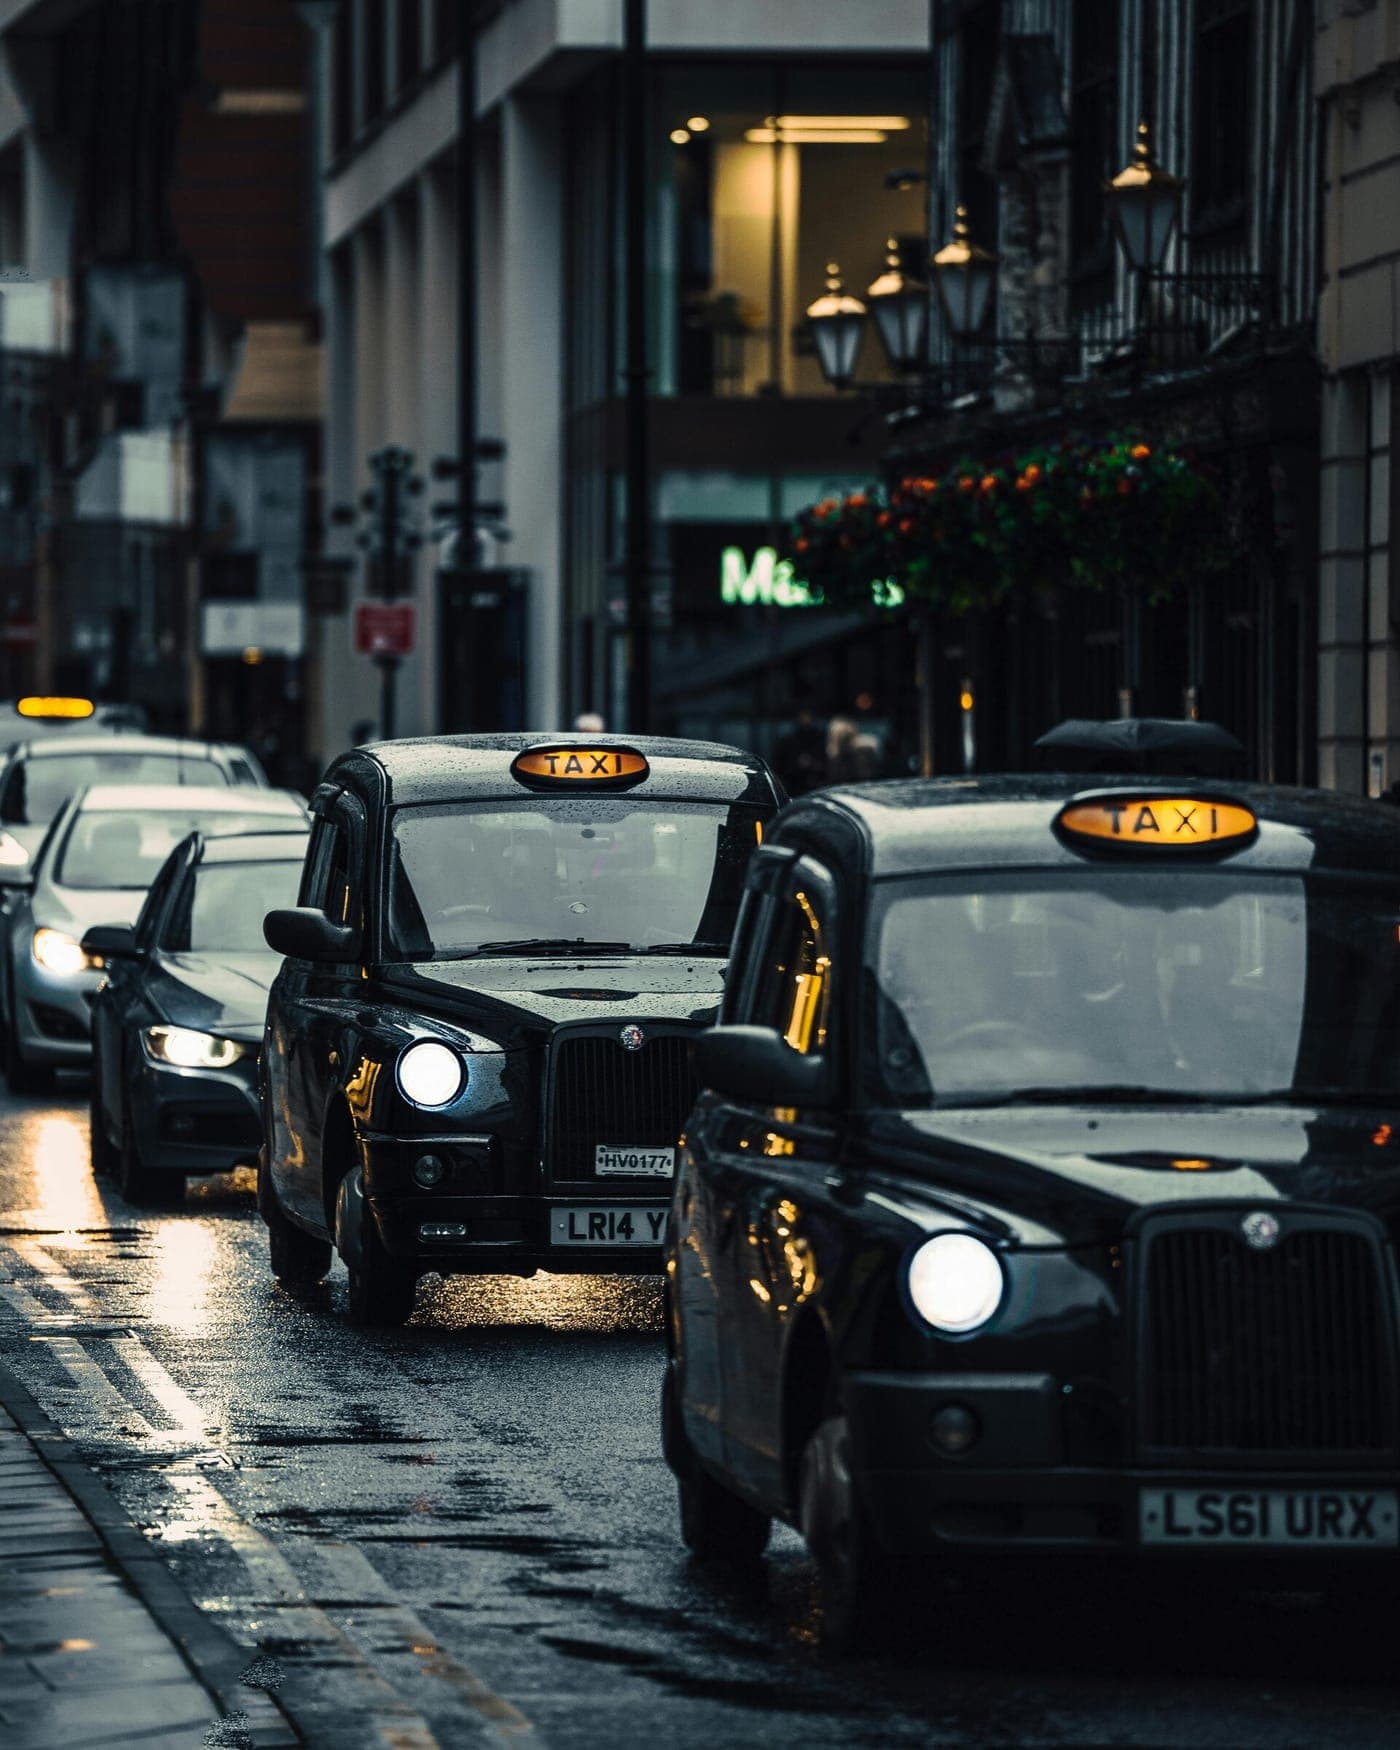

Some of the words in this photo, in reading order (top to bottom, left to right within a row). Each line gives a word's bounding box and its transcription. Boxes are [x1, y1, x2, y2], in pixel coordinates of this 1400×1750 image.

[544, 754, 622, 774] TAXI
[1103, 805, 1217, 834] TAXI
[604, 1154, 668, 1169] HV0177
[568, 1212, 635, 1240] LR14
[646, 1212, 673, 1240] Y
[1164, 1493, 1271, 1538] LS61
[1284, 1495, 1377, 1539] URX
